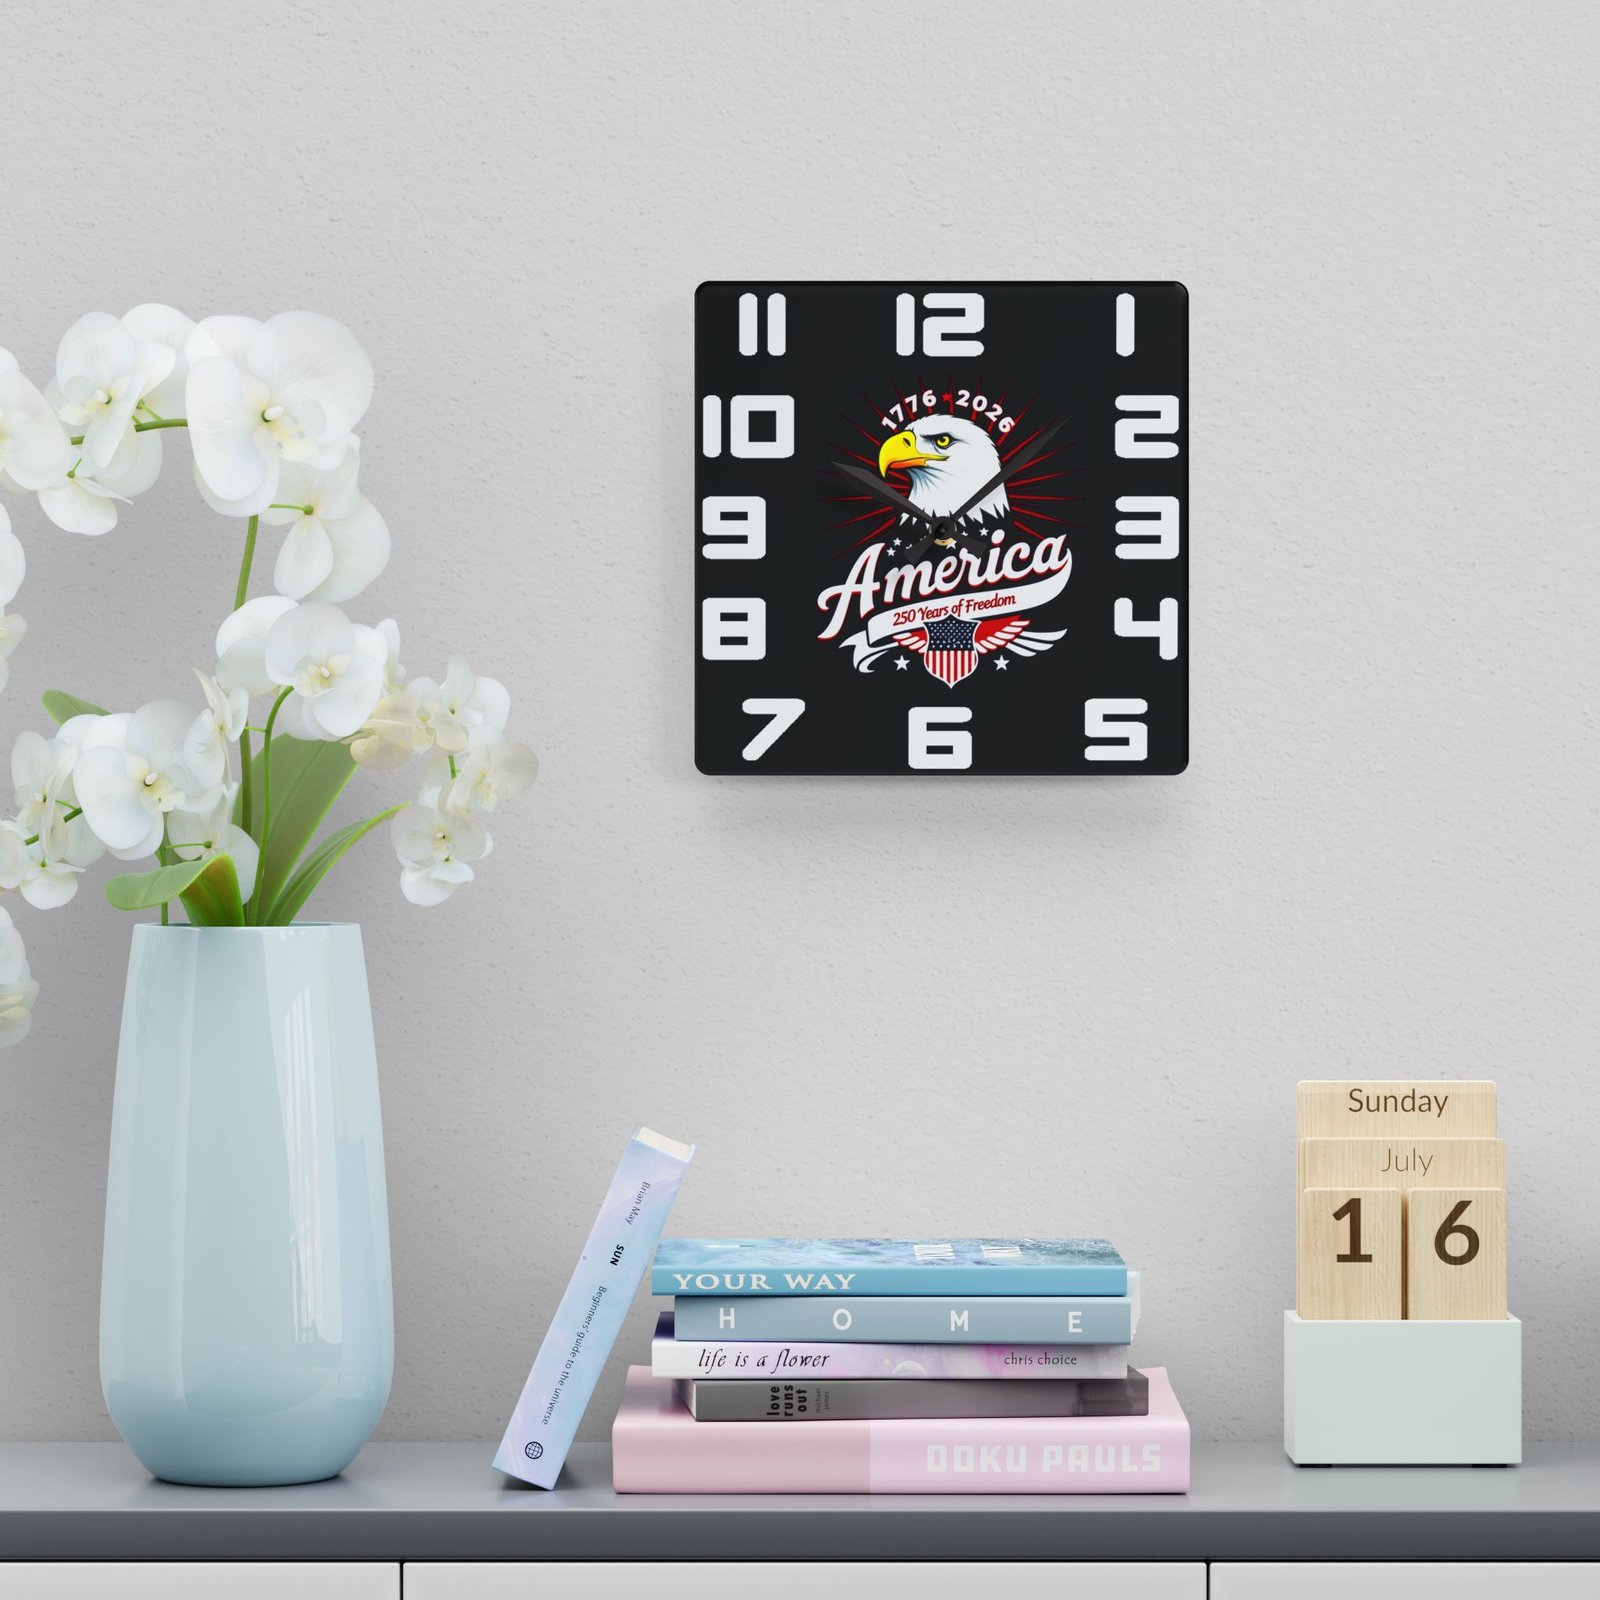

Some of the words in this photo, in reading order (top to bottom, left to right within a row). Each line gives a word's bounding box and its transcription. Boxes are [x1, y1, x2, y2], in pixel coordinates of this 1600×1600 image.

[738, 292, 787, 357] 11
[895, 292, 985, 357] 12
[1115, 292, 1136, 357] 1
[702, 394, 795, 459] 10
[881, 389, 937, 431] 1776
[955, 389, 1016, 433] 2026
[1114, 394, 1180, 459] 2
[701, 495, 767, 560] 9
[1114, 495, 1180, 560] 3
[817, 529, 1069, 641] America
[892, 609, 917, 627] 250
[917, 603, 950, 622] Years
[950, 598, 965, 617] of
[965, 592, 1017, 612] Freedom
[701, 597, 767, 661] 8
[1113, 597, 1179, 661] 4
[741, 697, 806, 762] 7
[908, 706, 973, 770] 6
[1084, 697, 1148, 762] 5
[1348, 1087, 1449, 1118] Sunday
[1380, 1147, 1434, 1177] July
[636, 1180, 651, 1206] Brian
[625, 1205, 640, 1226] May
[609, 1243, 625, 1267] SUN
[672, 1273, 773, 1290] YOUR
[783, 1273, 857, 1290] WAY
[581, 1285, 608, 1334] Beginners'
[570, 1331, 587, 1358] guide
[698, 1348, 726, 1374] life
[734, 1351, 749, 1367] is
[756, 1354, 767, 1367] a
[770, 1348, 831, 1375] flower
[1004, 1352, 1034, 1365] chris
[1037, 1352, 1077, 1365] choice
[556, 1368, 570, 1387] the
[564, 1357, 573, 1370] to
[541, 1386, 563, 1426] universe
[766, 1386, 780, 1416] love
[784, 1384, 794, 1417] runs
[797, 1388, 807, 1413] out
[926, 1445, 1027, 1473] DOKU
[1042, 1445, 1161, 1473] PAULS
